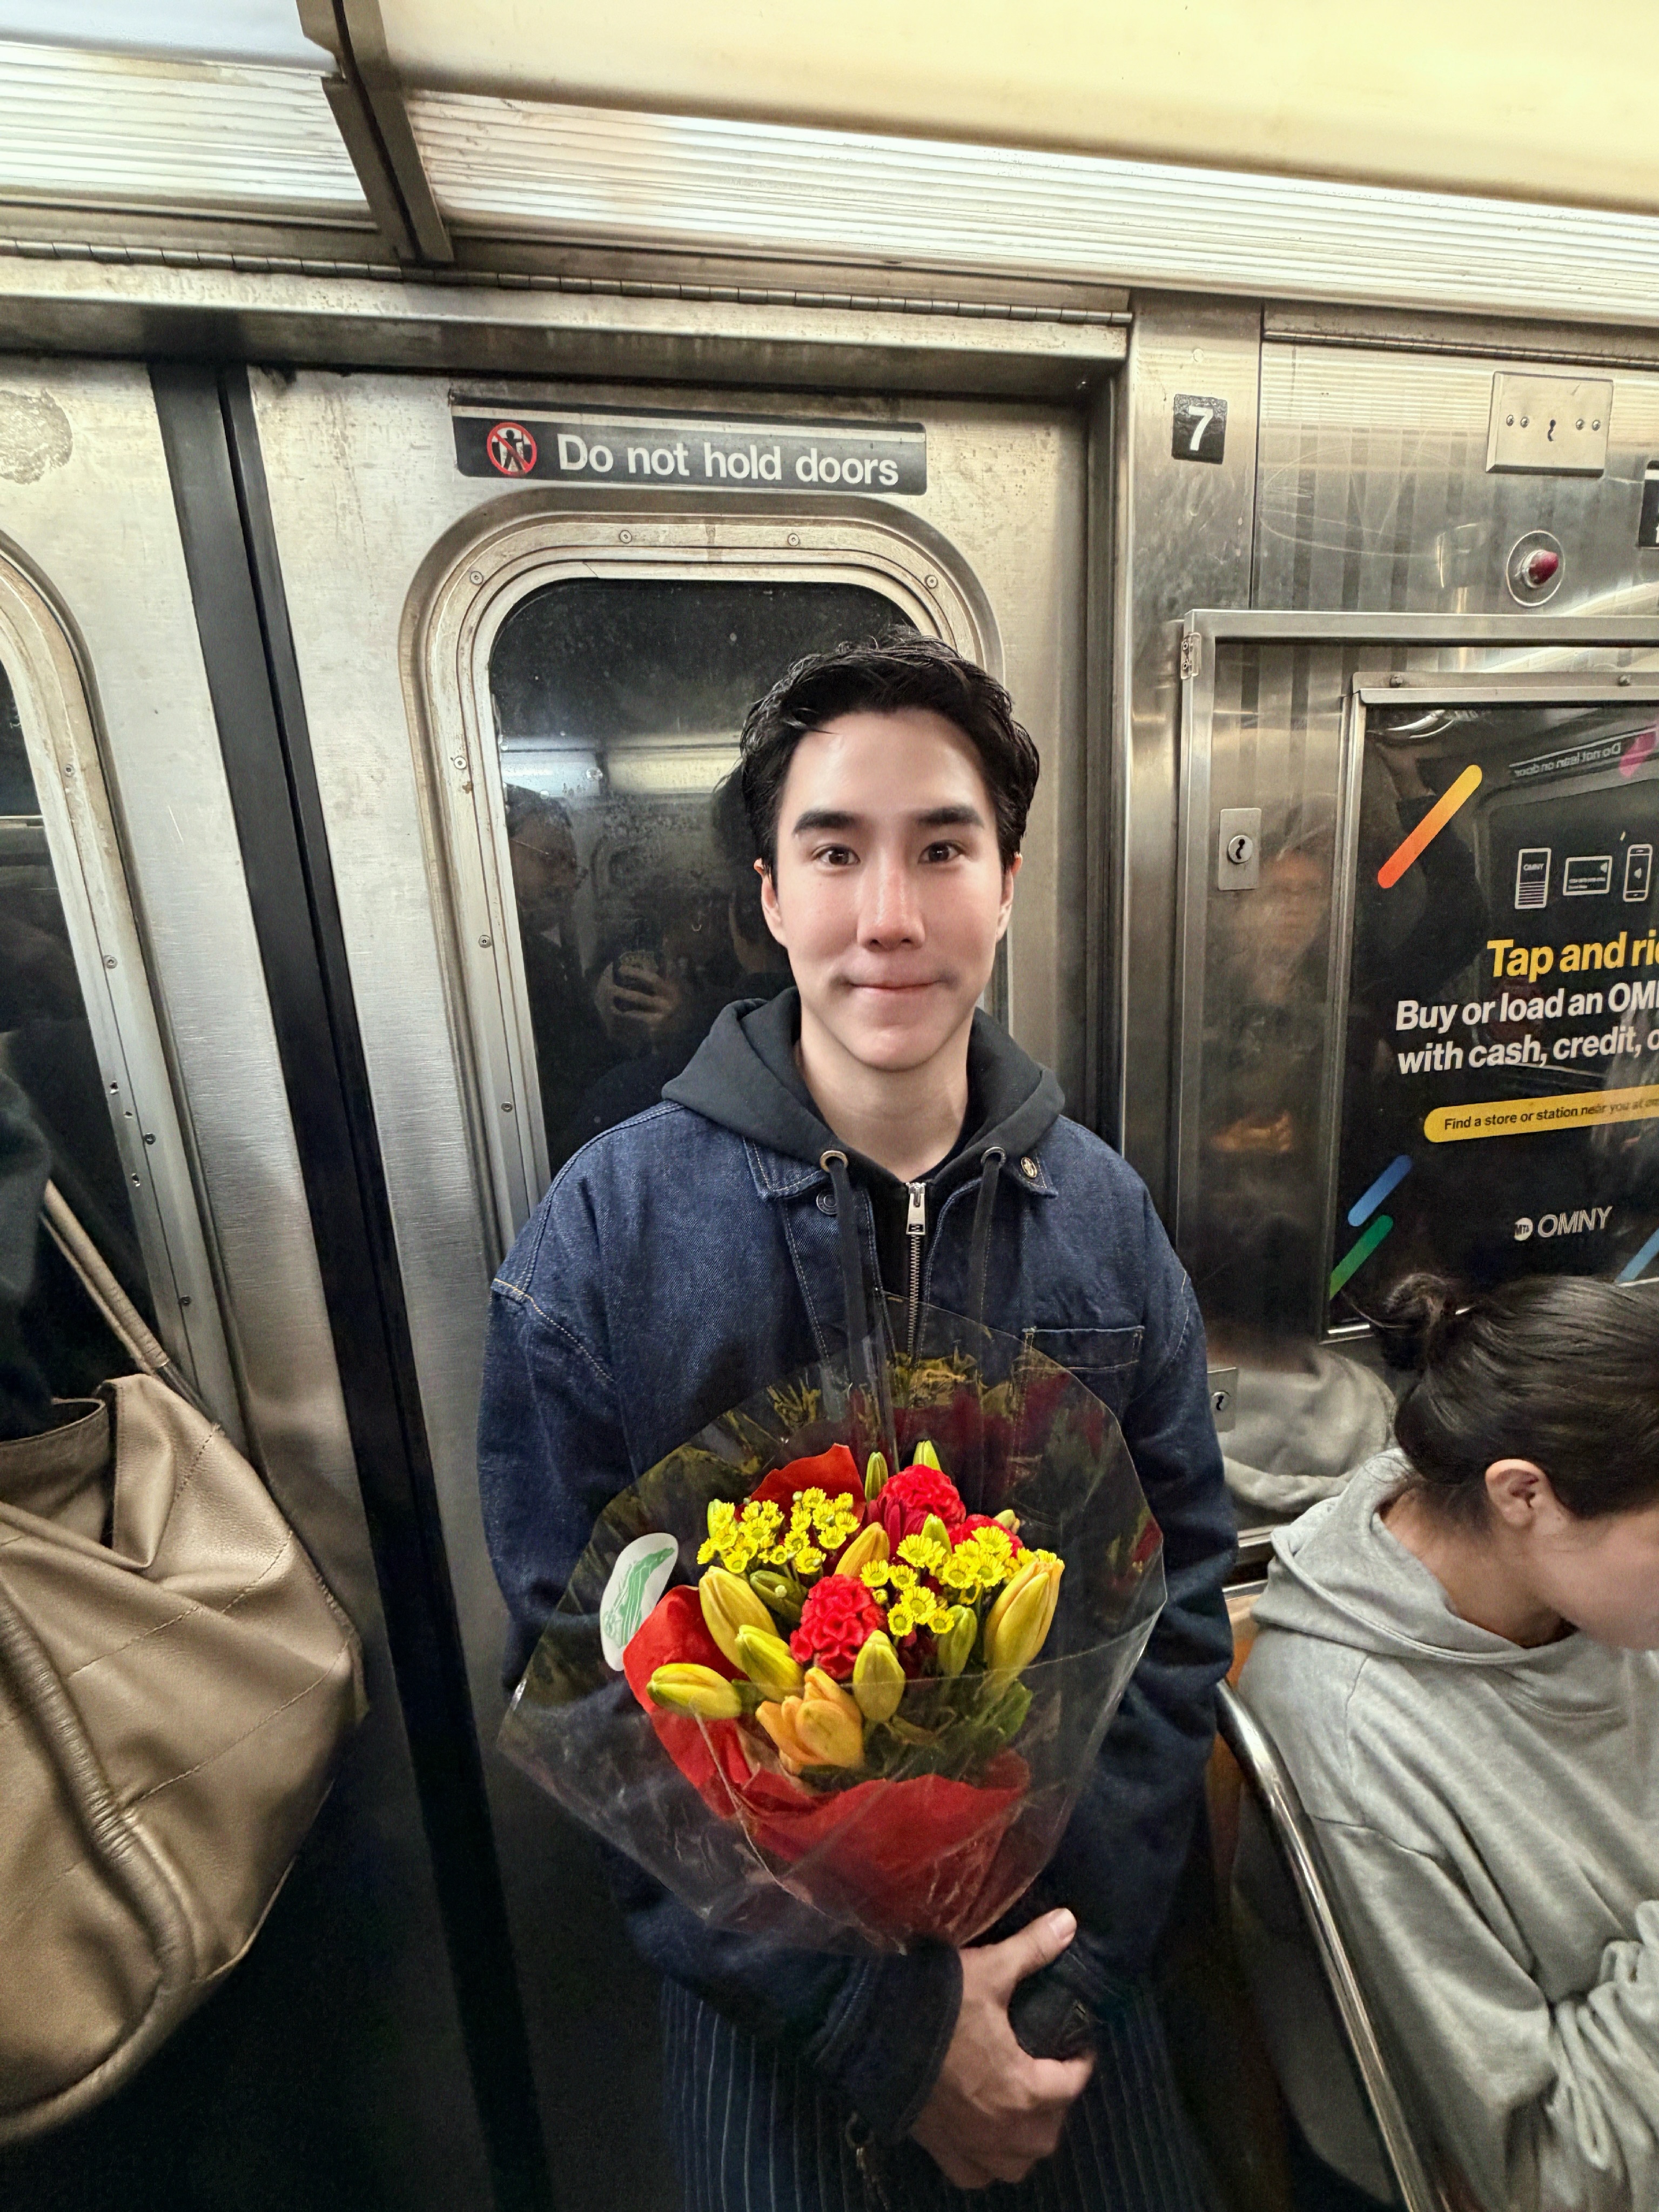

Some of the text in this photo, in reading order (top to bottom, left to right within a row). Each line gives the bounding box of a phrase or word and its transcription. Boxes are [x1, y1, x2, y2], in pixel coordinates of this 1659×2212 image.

[1188, 405, 1213, 451] 7
[557, 433, 899, 486] Do not hold doors
[1487, 939, 1554, 983] Tap
[1559, 931, 1628, 973] and
[1395, 980, 1659, 1034] Buy or load an OM
[1398, 1041, 1464, 1075] with
[1468, 1034, 1548, 1068] cash,
[1553, 1025, 1642, 1061] credit,
[1445, 1116, 1472, 1130] Find
[1474, 1117, 1482, 1127] a
[1485, 1114, 1518, 1126] store
[1520, 1112, 1535, 1122] or
[1536, 1107, 1578, 1121] station
[1581, 1103, 1608, 1116] near
[1537, 1205, 1614, 1238] OMNY
